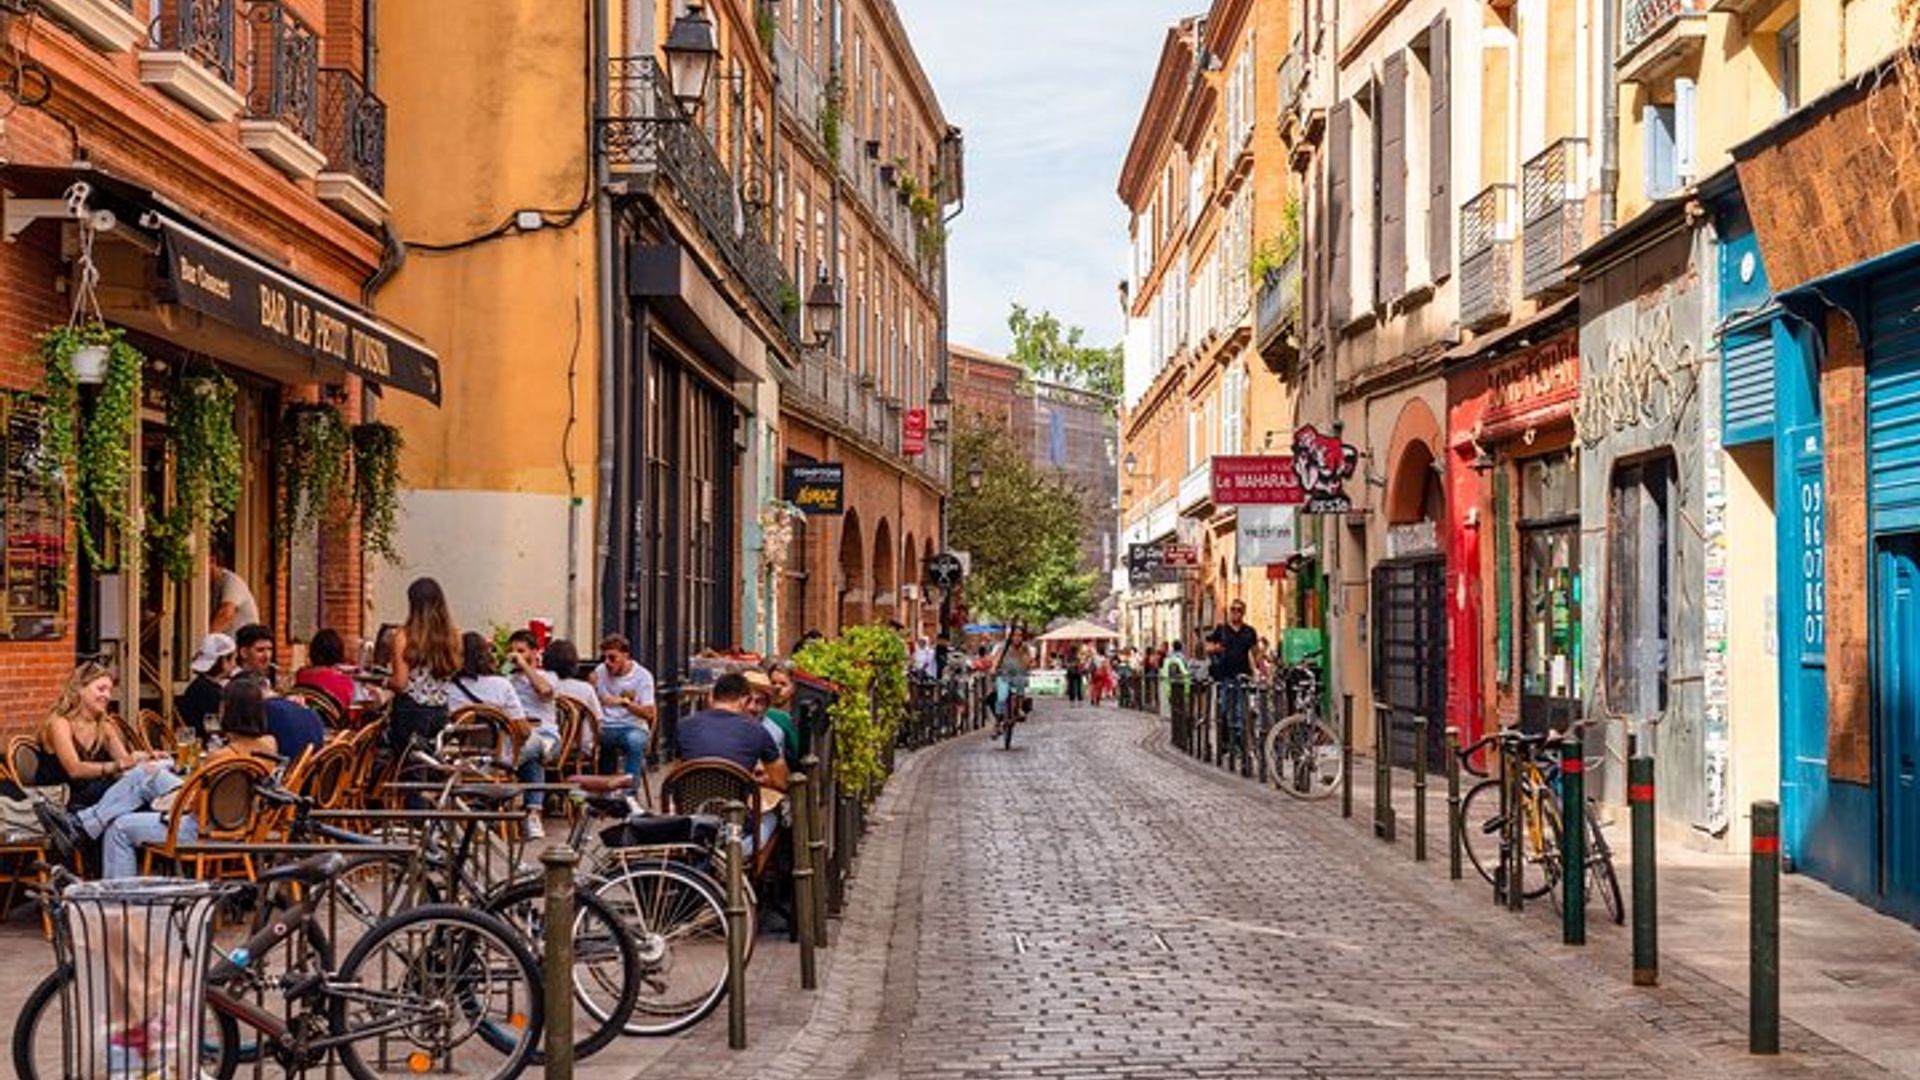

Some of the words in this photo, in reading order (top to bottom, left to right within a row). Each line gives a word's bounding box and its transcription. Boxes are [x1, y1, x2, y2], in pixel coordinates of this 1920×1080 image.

[259, 284, 289, 336] BAR
[293, 300, 312, 345] LE
[315, 310, 349, 360] PETIT
[352, 328, 392, 377] VOISIN
[1216, 474, 1231, 488] Le
